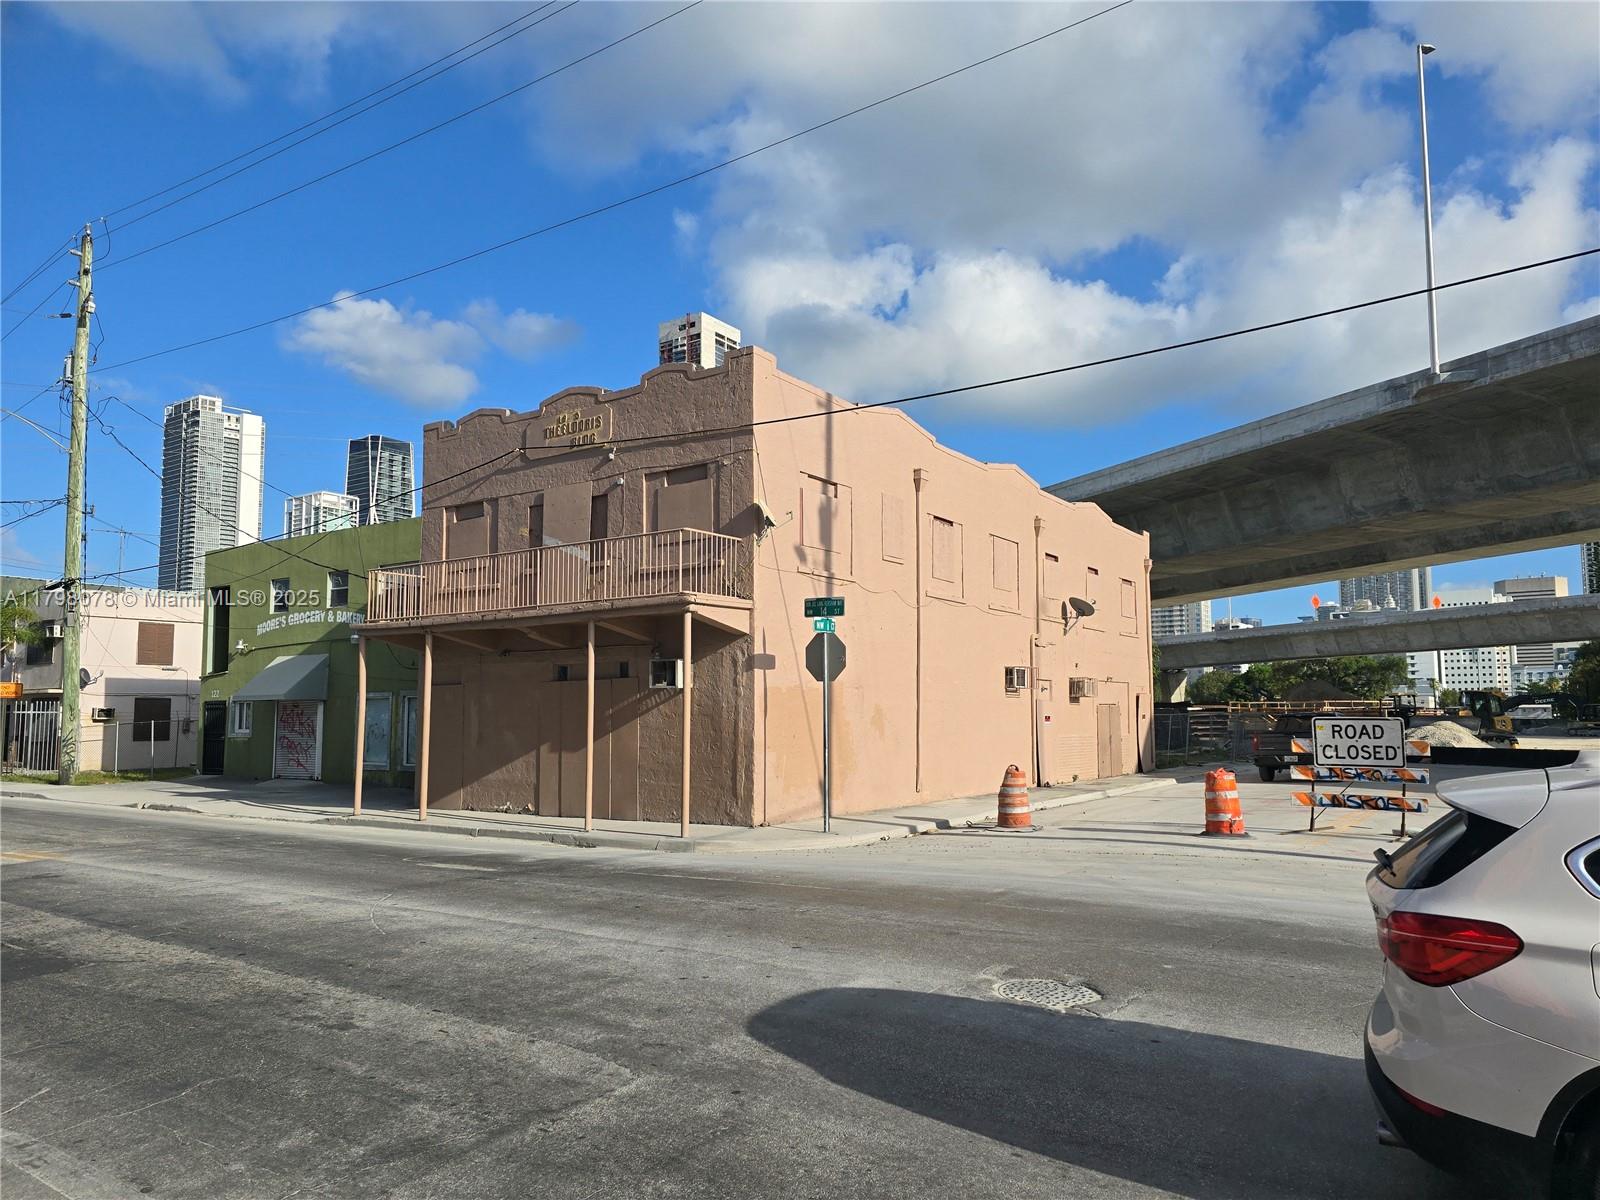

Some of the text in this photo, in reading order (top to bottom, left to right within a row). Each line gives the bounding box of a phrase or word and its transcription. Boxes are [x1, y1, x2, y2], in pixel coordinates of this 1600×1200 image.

[256, 610, 366, 636] MOORE'S GROCERY & BAKERY
[816, 621, 824, 629] NW
[211, 690, 219, 698] 122
[1331, 724, 1385, 740] ROAD
[1322, 744, 1398, 761] CLOSED
